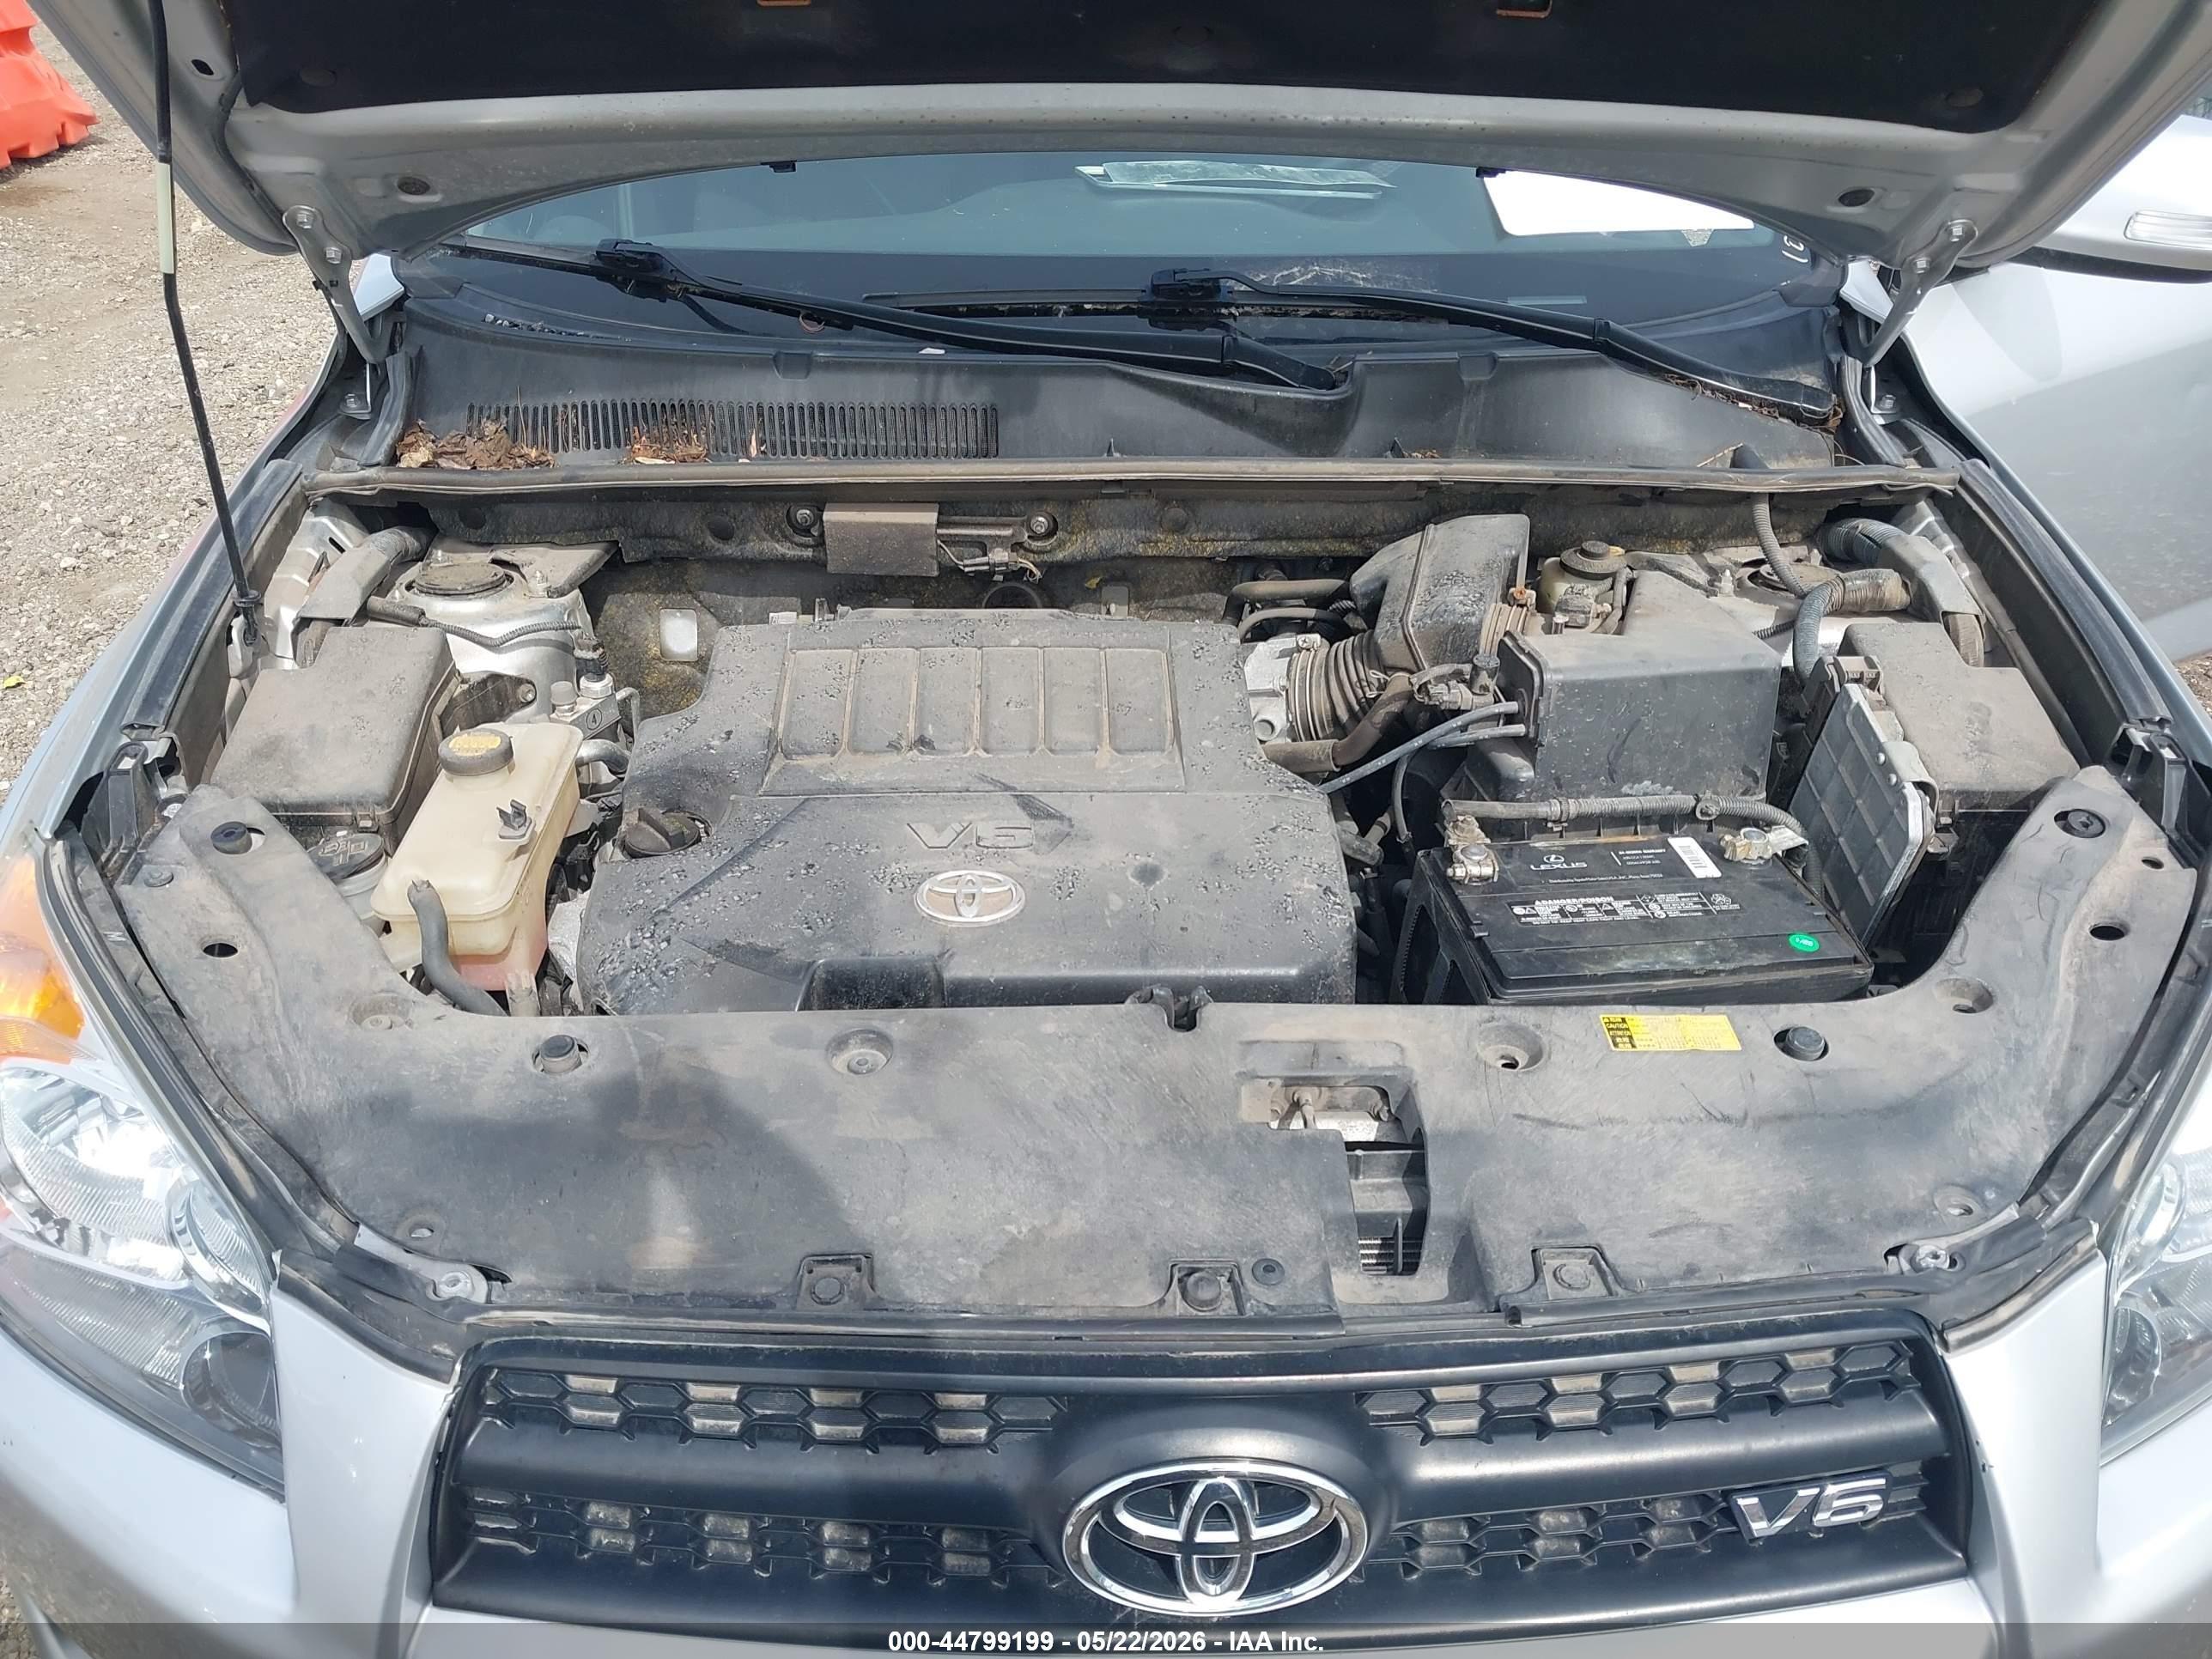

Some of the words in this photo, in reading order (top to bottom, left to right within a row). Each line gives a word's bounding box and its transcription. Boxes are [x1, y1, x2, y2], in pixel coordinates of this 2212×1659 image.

[906, 822, 1034, 849] V6
[1530, 861, 1588, 871] LEXUS
[1736, 1478, 1887, 1538] V6
